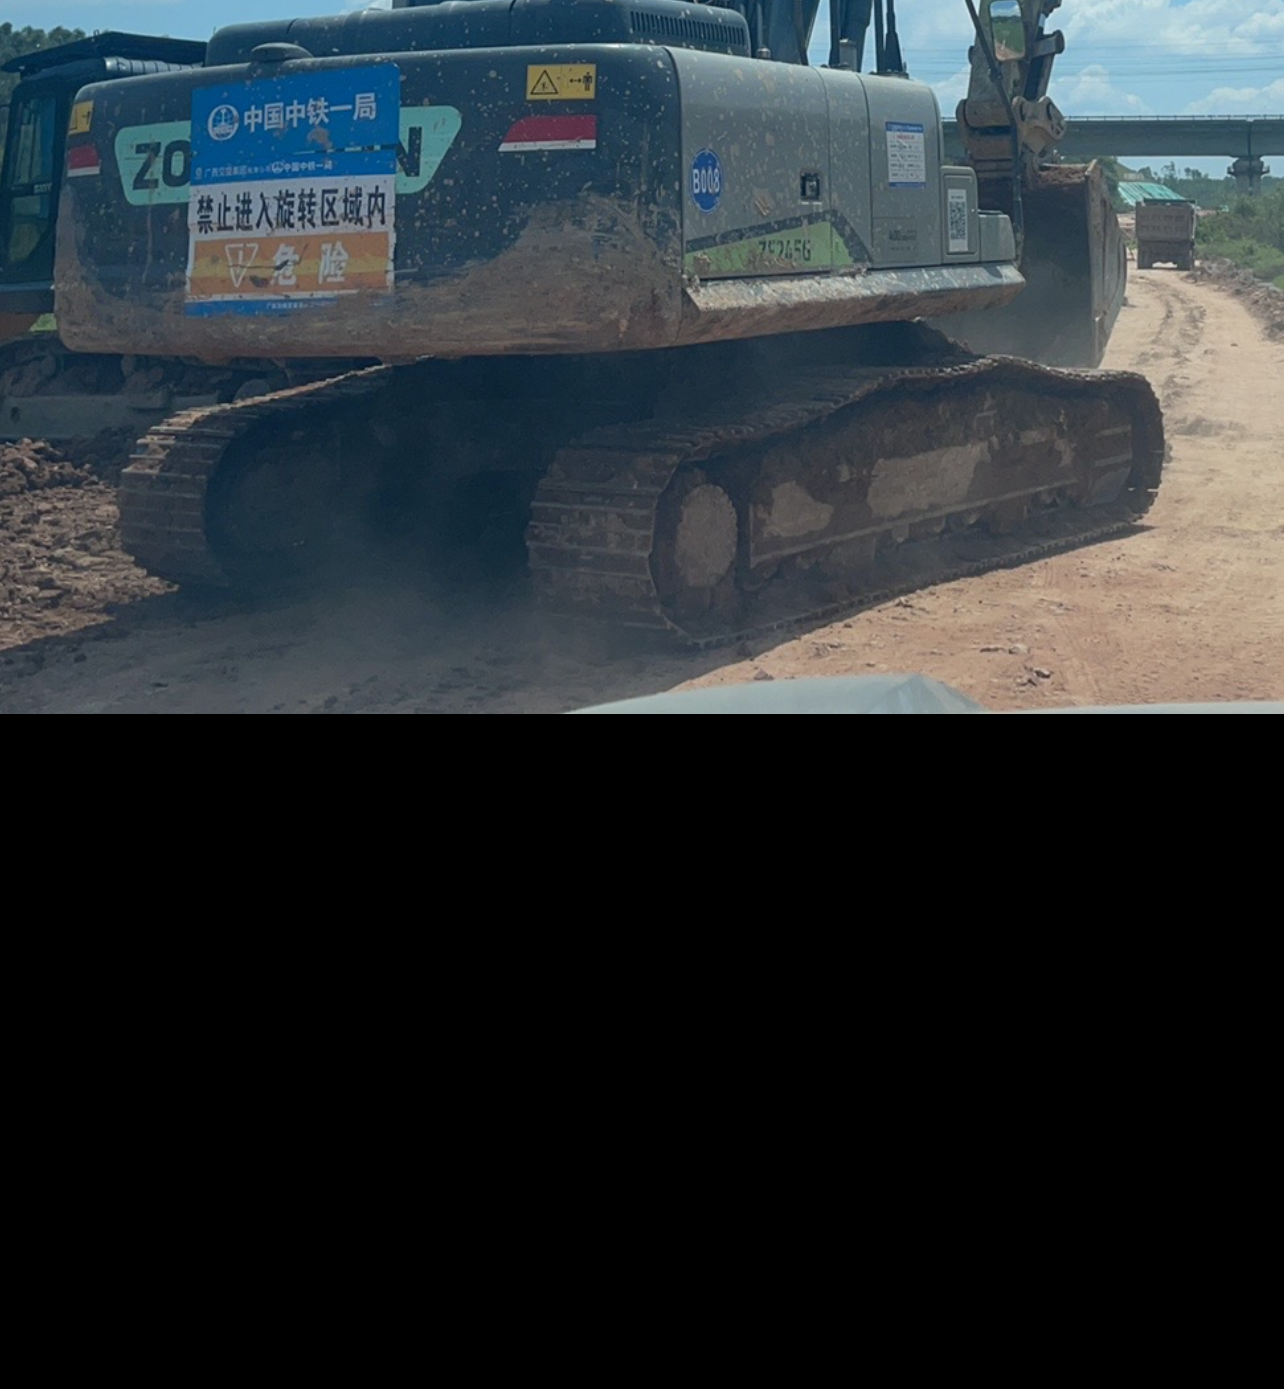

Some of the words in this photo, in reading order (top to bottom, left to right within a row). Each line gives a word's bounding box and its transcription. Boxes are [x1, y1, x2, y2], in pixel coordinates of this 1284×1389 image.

[244, 92, 376, 132] 中国中铁一局
[692, 167, 720, 194] B008
[197, 185, 386, 234] 禁止进入旋转区域内
[270, 241, 349, 286] 危险
